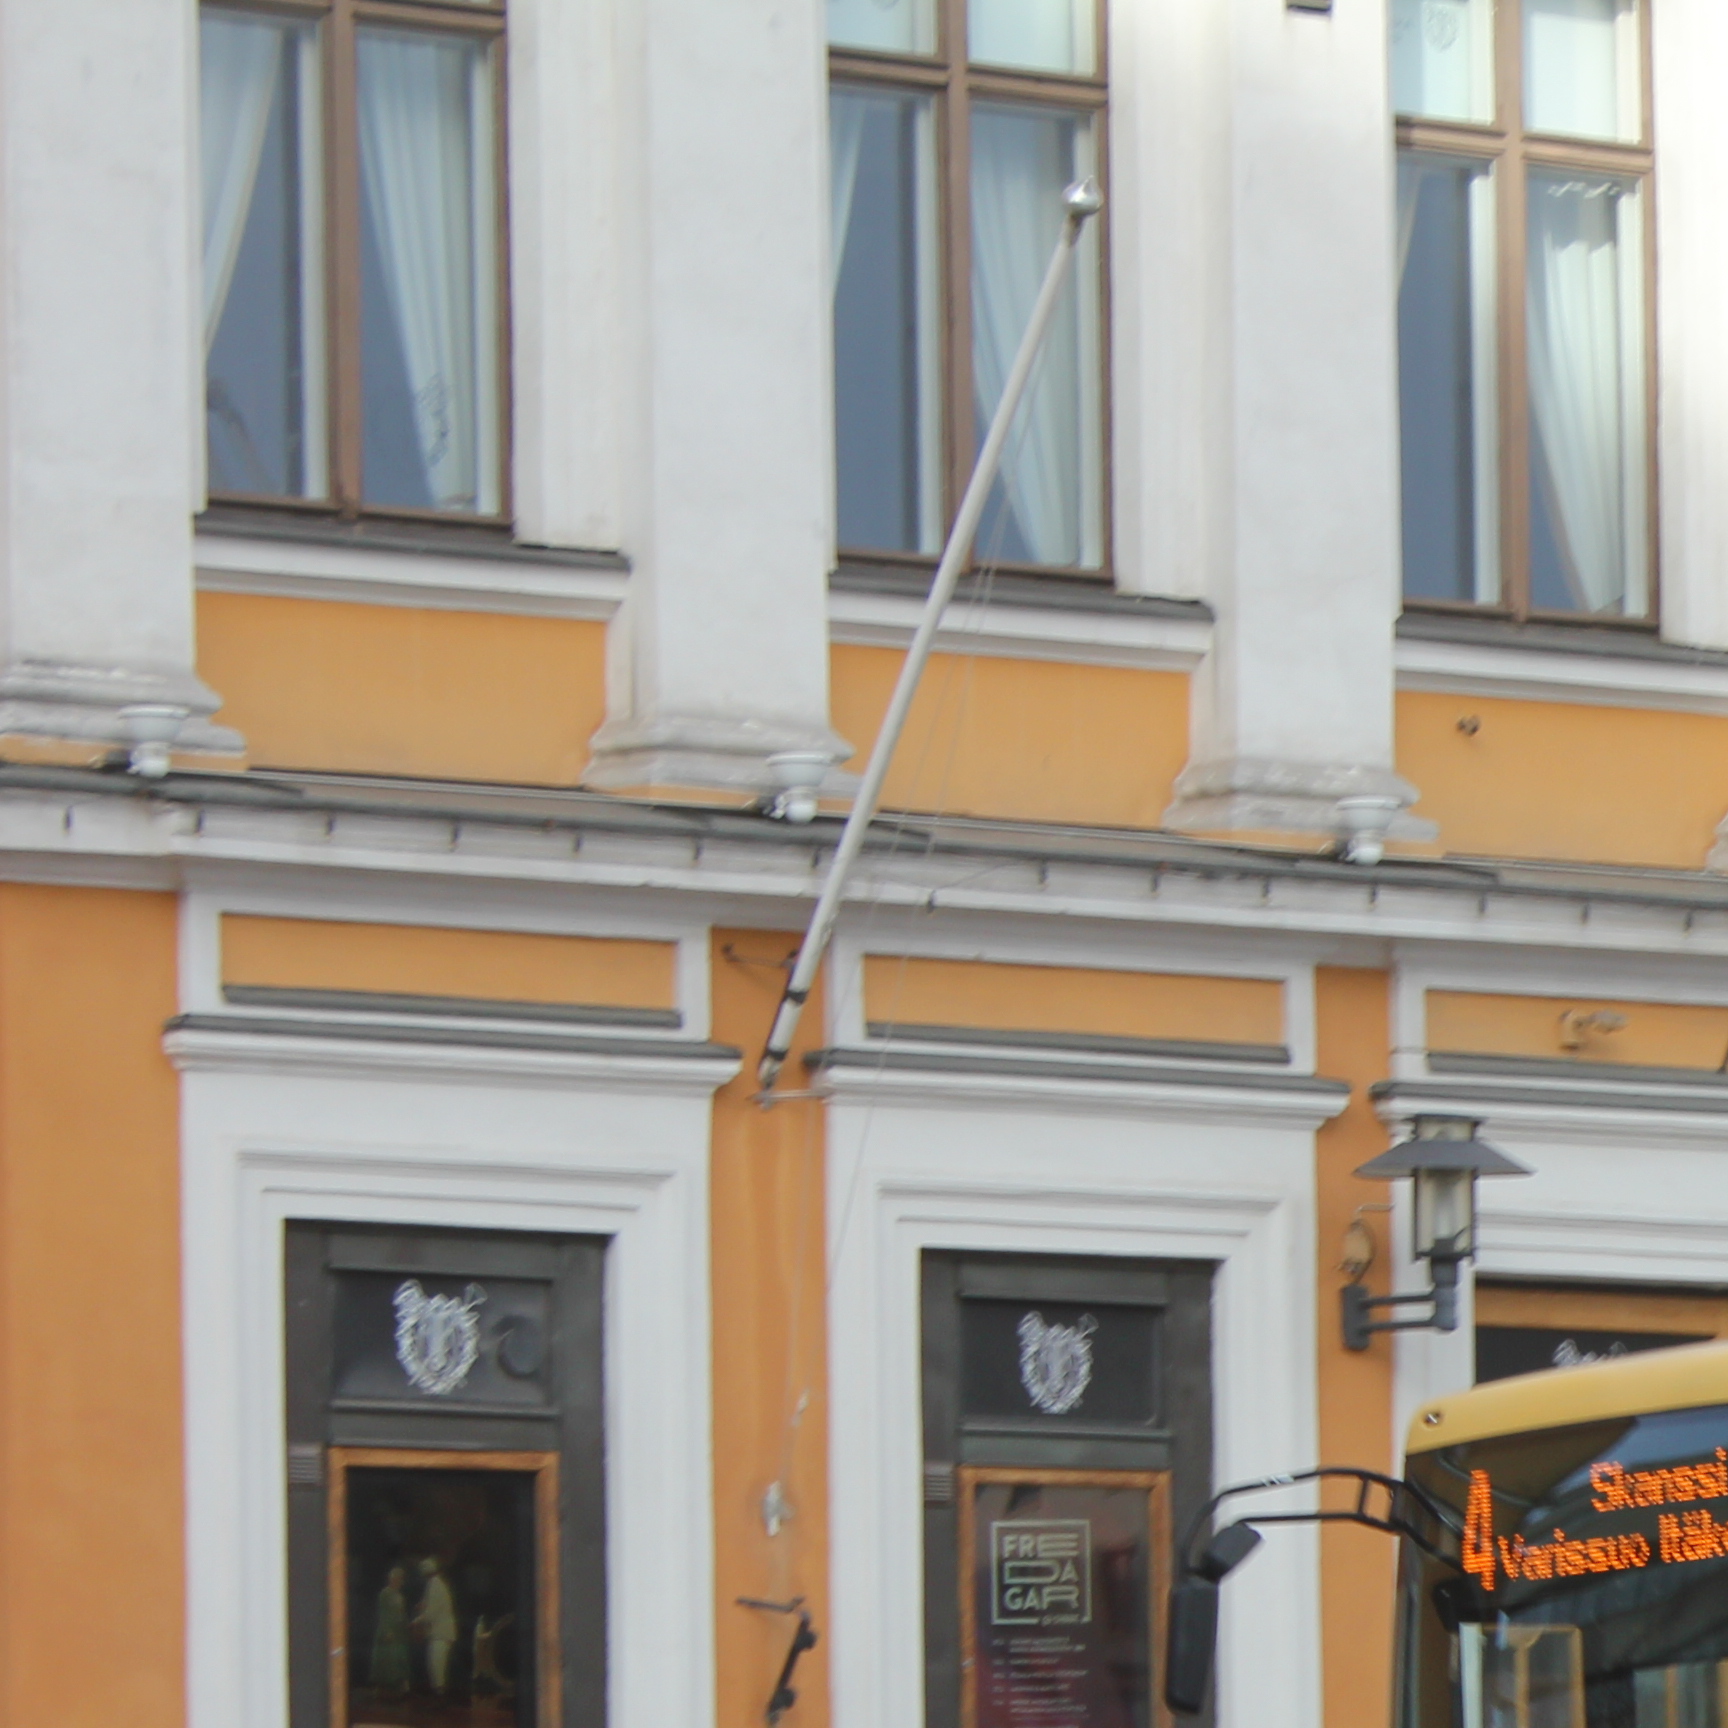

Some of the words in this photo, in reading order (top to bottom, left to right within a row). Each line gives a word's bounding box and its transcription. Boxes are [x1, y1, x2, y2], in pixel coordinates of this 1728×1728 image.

[1589, 1446, 1728, 1512] Skanssi
[1462, 1469, 1496, 1591] 4
[1497, 1528, 1651, 1581] Varissuo
